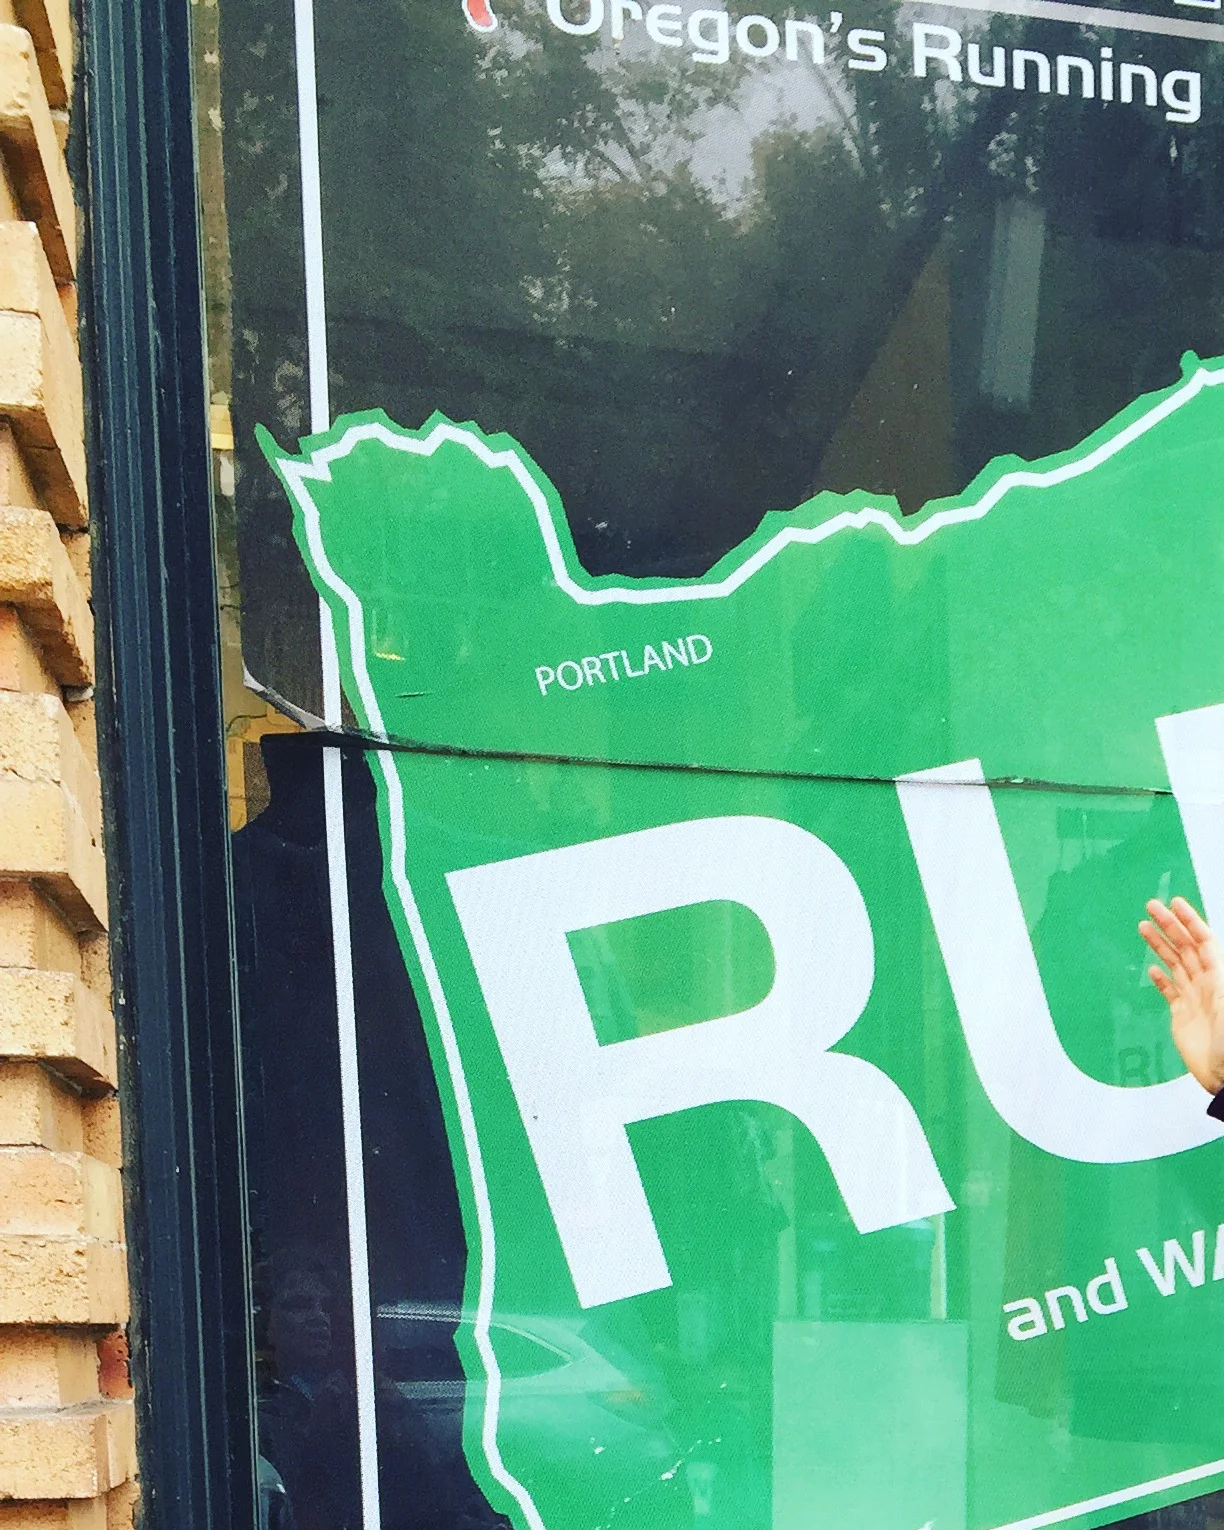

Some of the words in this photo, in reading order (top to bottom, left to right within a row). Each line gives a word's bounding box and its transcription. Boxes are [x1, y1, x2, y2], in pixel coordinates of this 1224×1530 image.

[546, 0, 887, 71] Oregon's
[911, 21, 1201, 122] Running
[535, 634, 713, 696] PORTLAND
[1003, 1258, 1128, 1341] and
